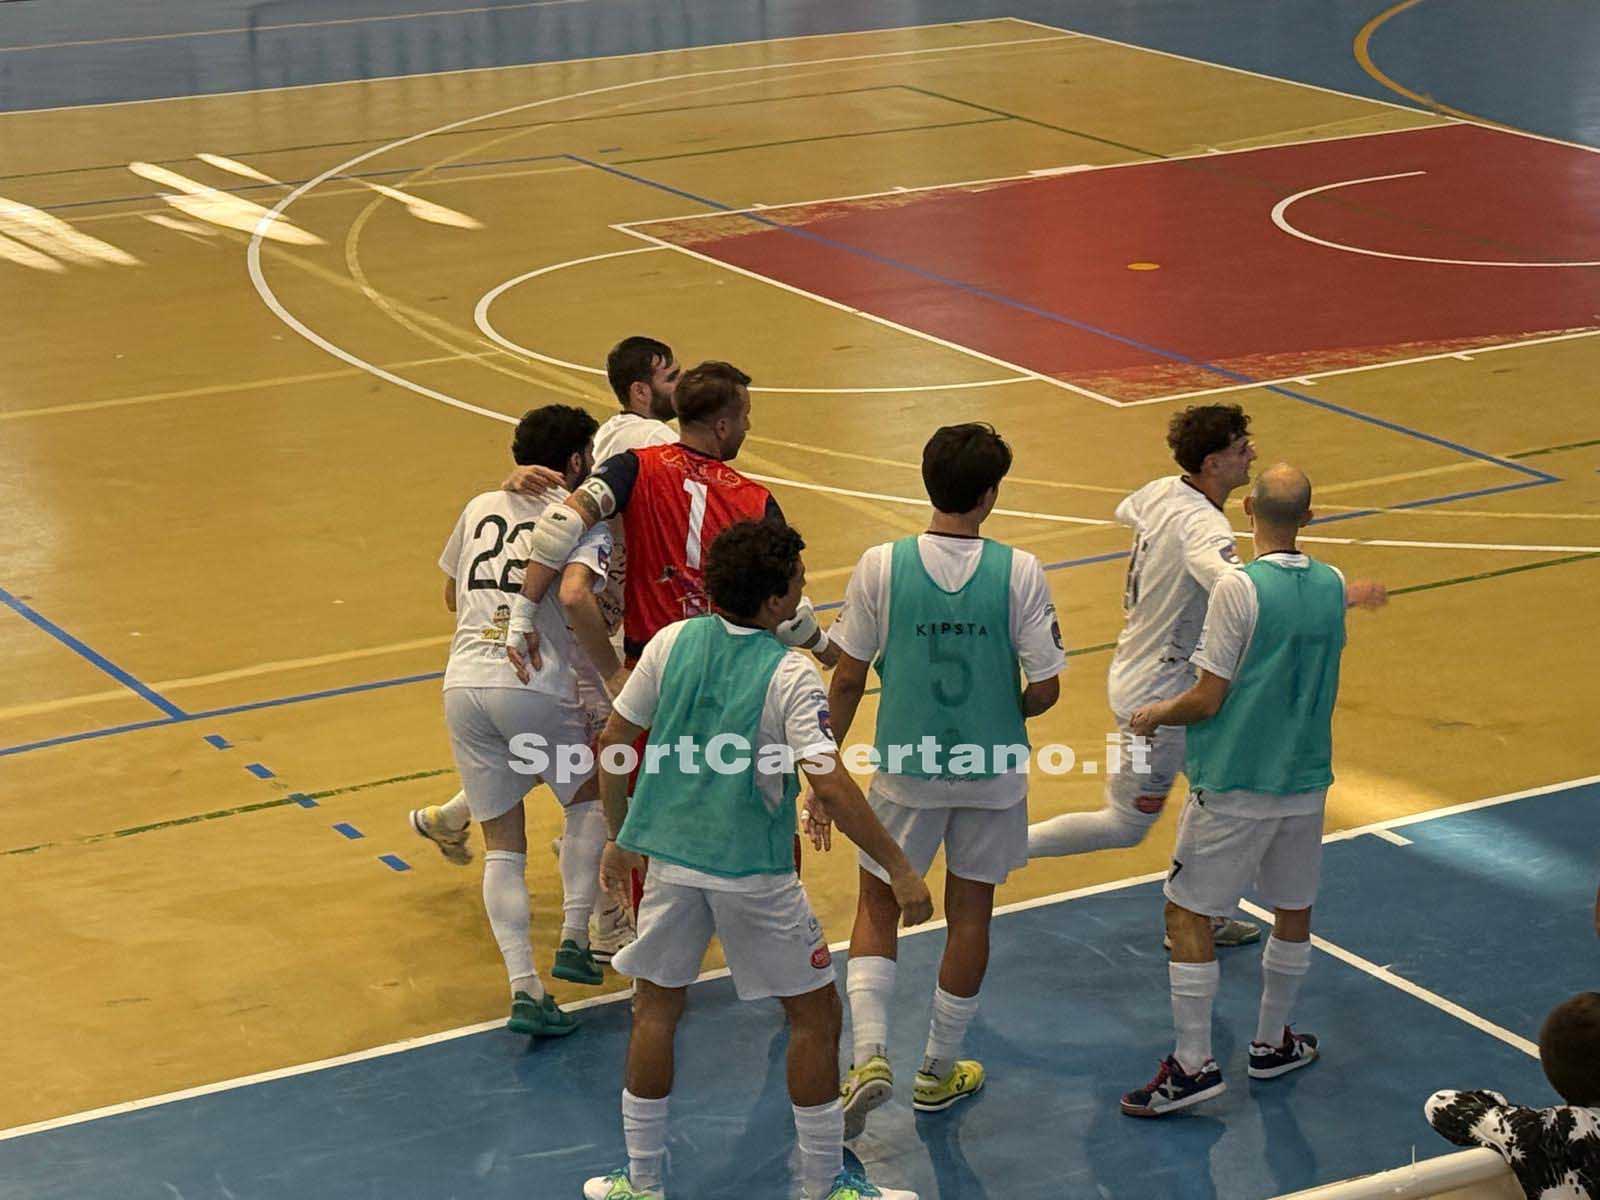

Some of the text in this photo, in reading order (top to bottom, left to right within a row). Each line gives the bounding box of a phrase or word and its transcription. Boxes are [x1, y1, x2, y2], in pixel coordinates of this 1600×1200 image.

[467, 514, 536, 593] 22
[683, 478, 708, 570] 1
[916, 622, 989, 637] KIPSTA
[928, 629, 972, 707] 5
